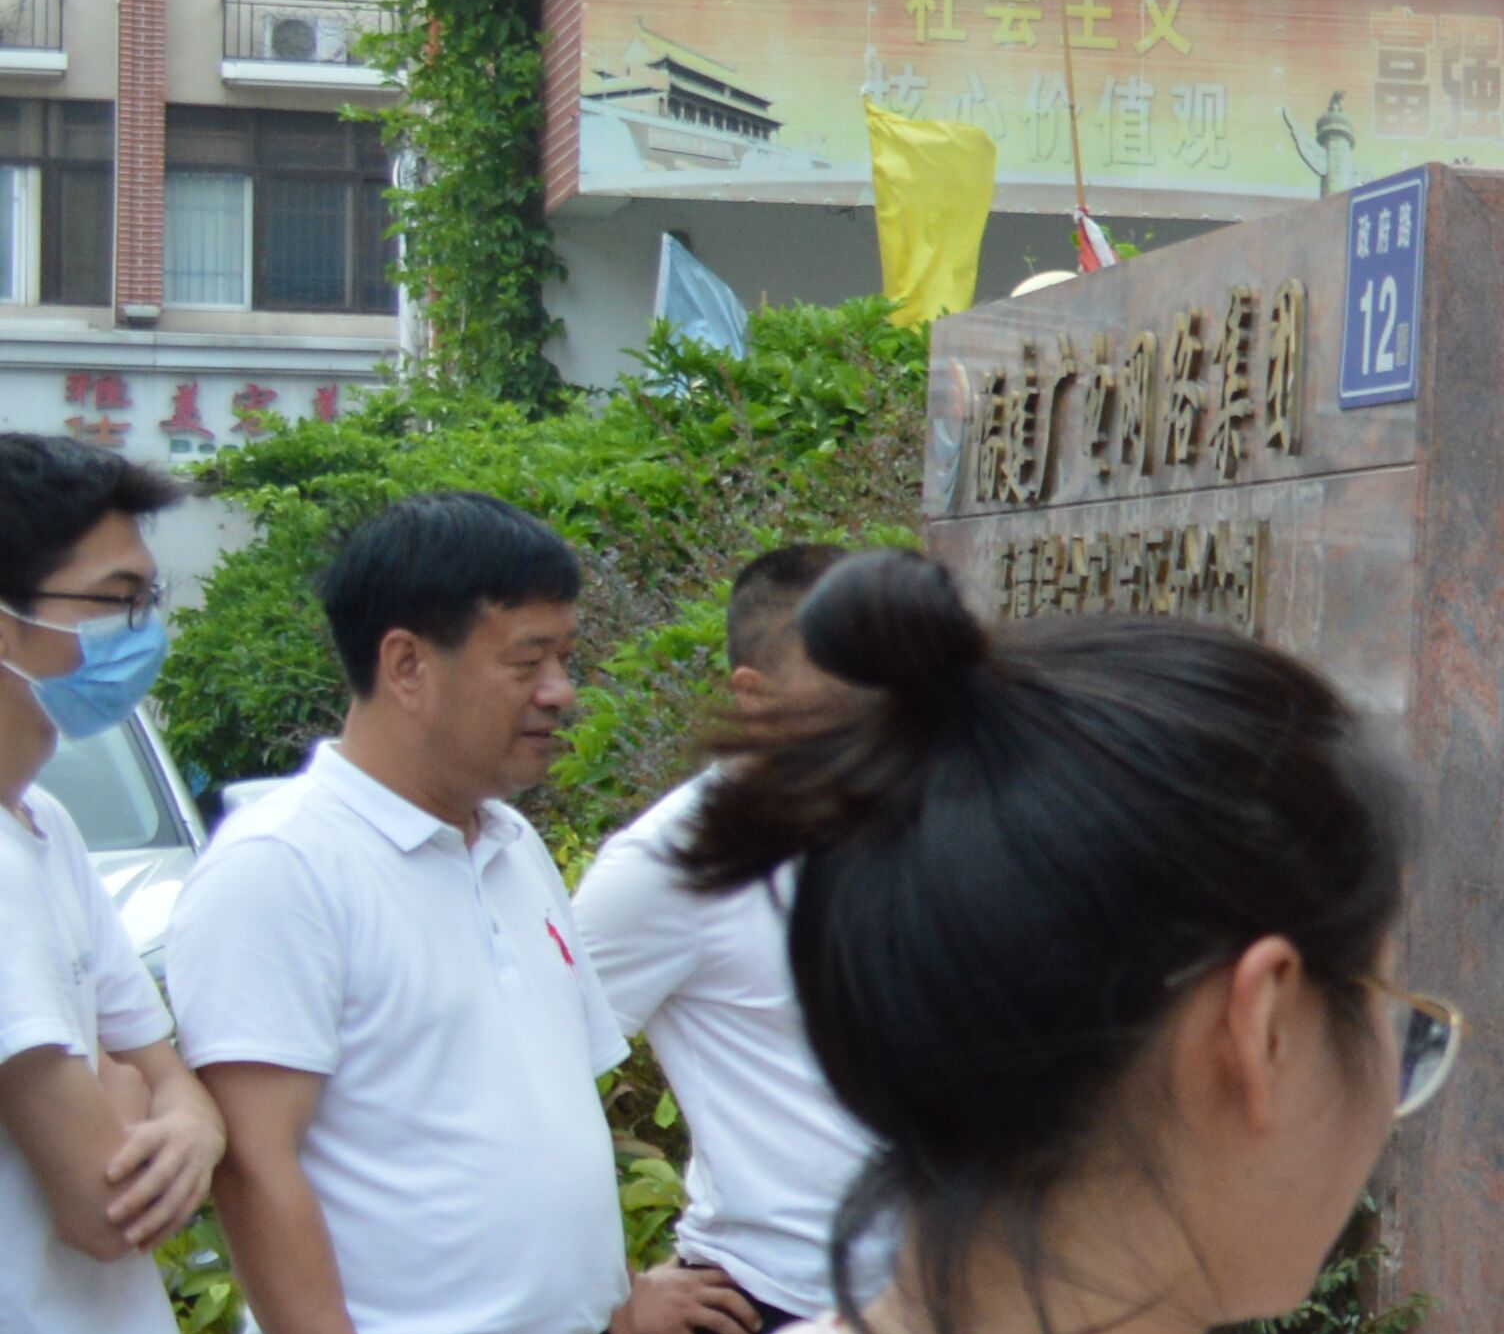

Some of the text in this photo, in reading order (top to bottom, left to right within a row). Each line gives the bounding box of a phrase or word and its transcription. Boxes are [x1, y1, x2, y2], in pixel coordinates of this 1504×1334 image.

[1357, 201, 1413, 259] 政府路
[1359, 275, 1398, 376] 12
